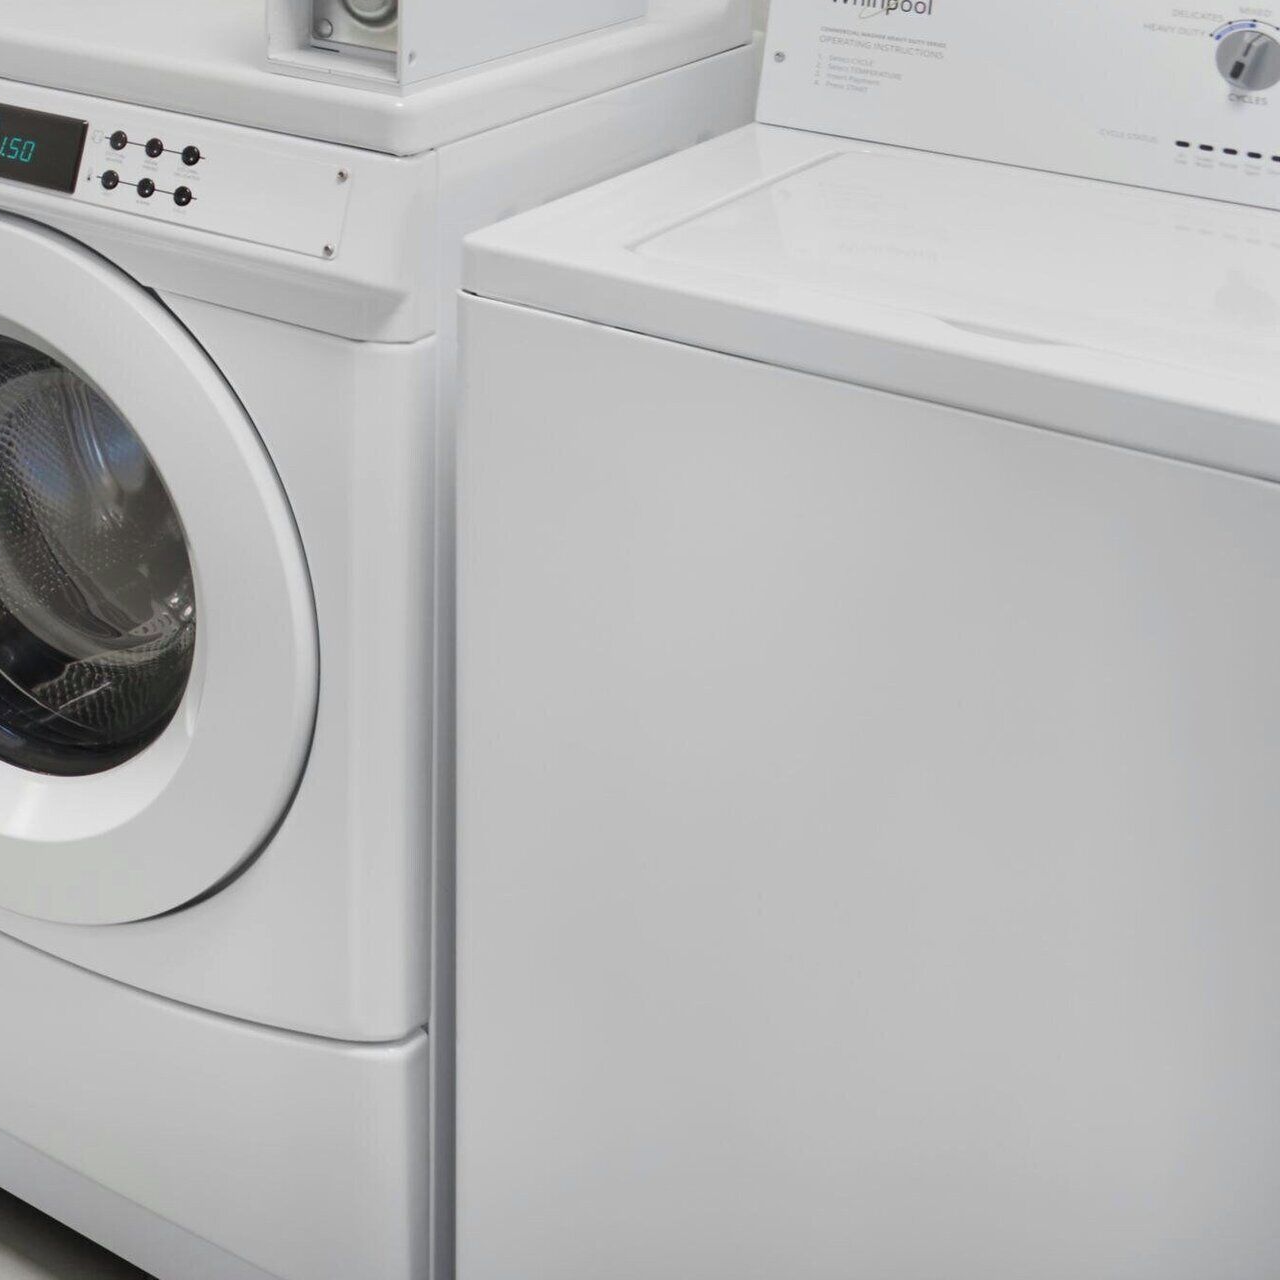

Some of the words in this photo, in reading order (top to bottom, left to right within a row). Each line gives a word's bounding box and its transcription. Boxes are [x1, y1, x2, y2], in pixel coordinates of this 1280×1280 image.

[819, 35, 872, 50] OPERATING
[873, 41, 945, 60] INSTRUCTIONS
[1227, 92, 1269, 106] CYCLES
